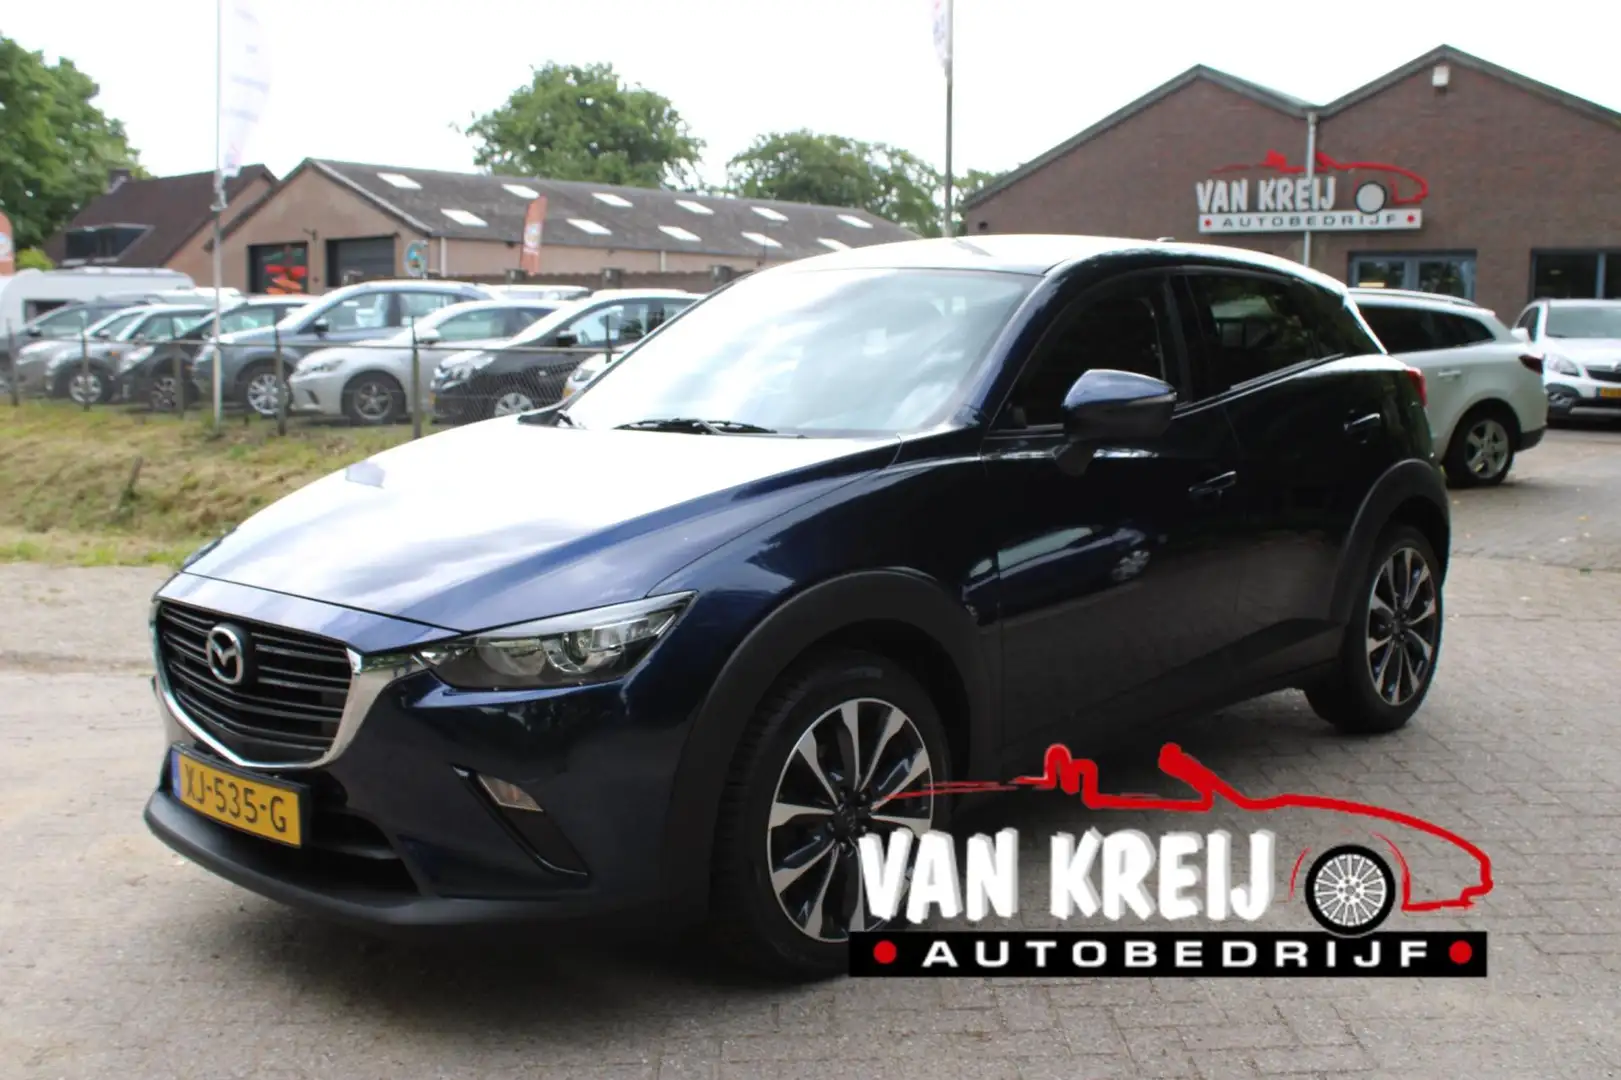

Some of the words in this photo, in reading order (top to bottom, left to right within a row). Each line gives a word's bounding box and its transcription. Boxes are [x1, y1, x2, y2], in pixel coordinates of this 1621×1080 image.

[1196, 178, 1249, 213] VAN
[1257, 175, 1337, 212] KREIJ
[1222, 214, 1398, 228] AUTOBEDRIJF
[184, 763, 287, 833] XJ-535-G
